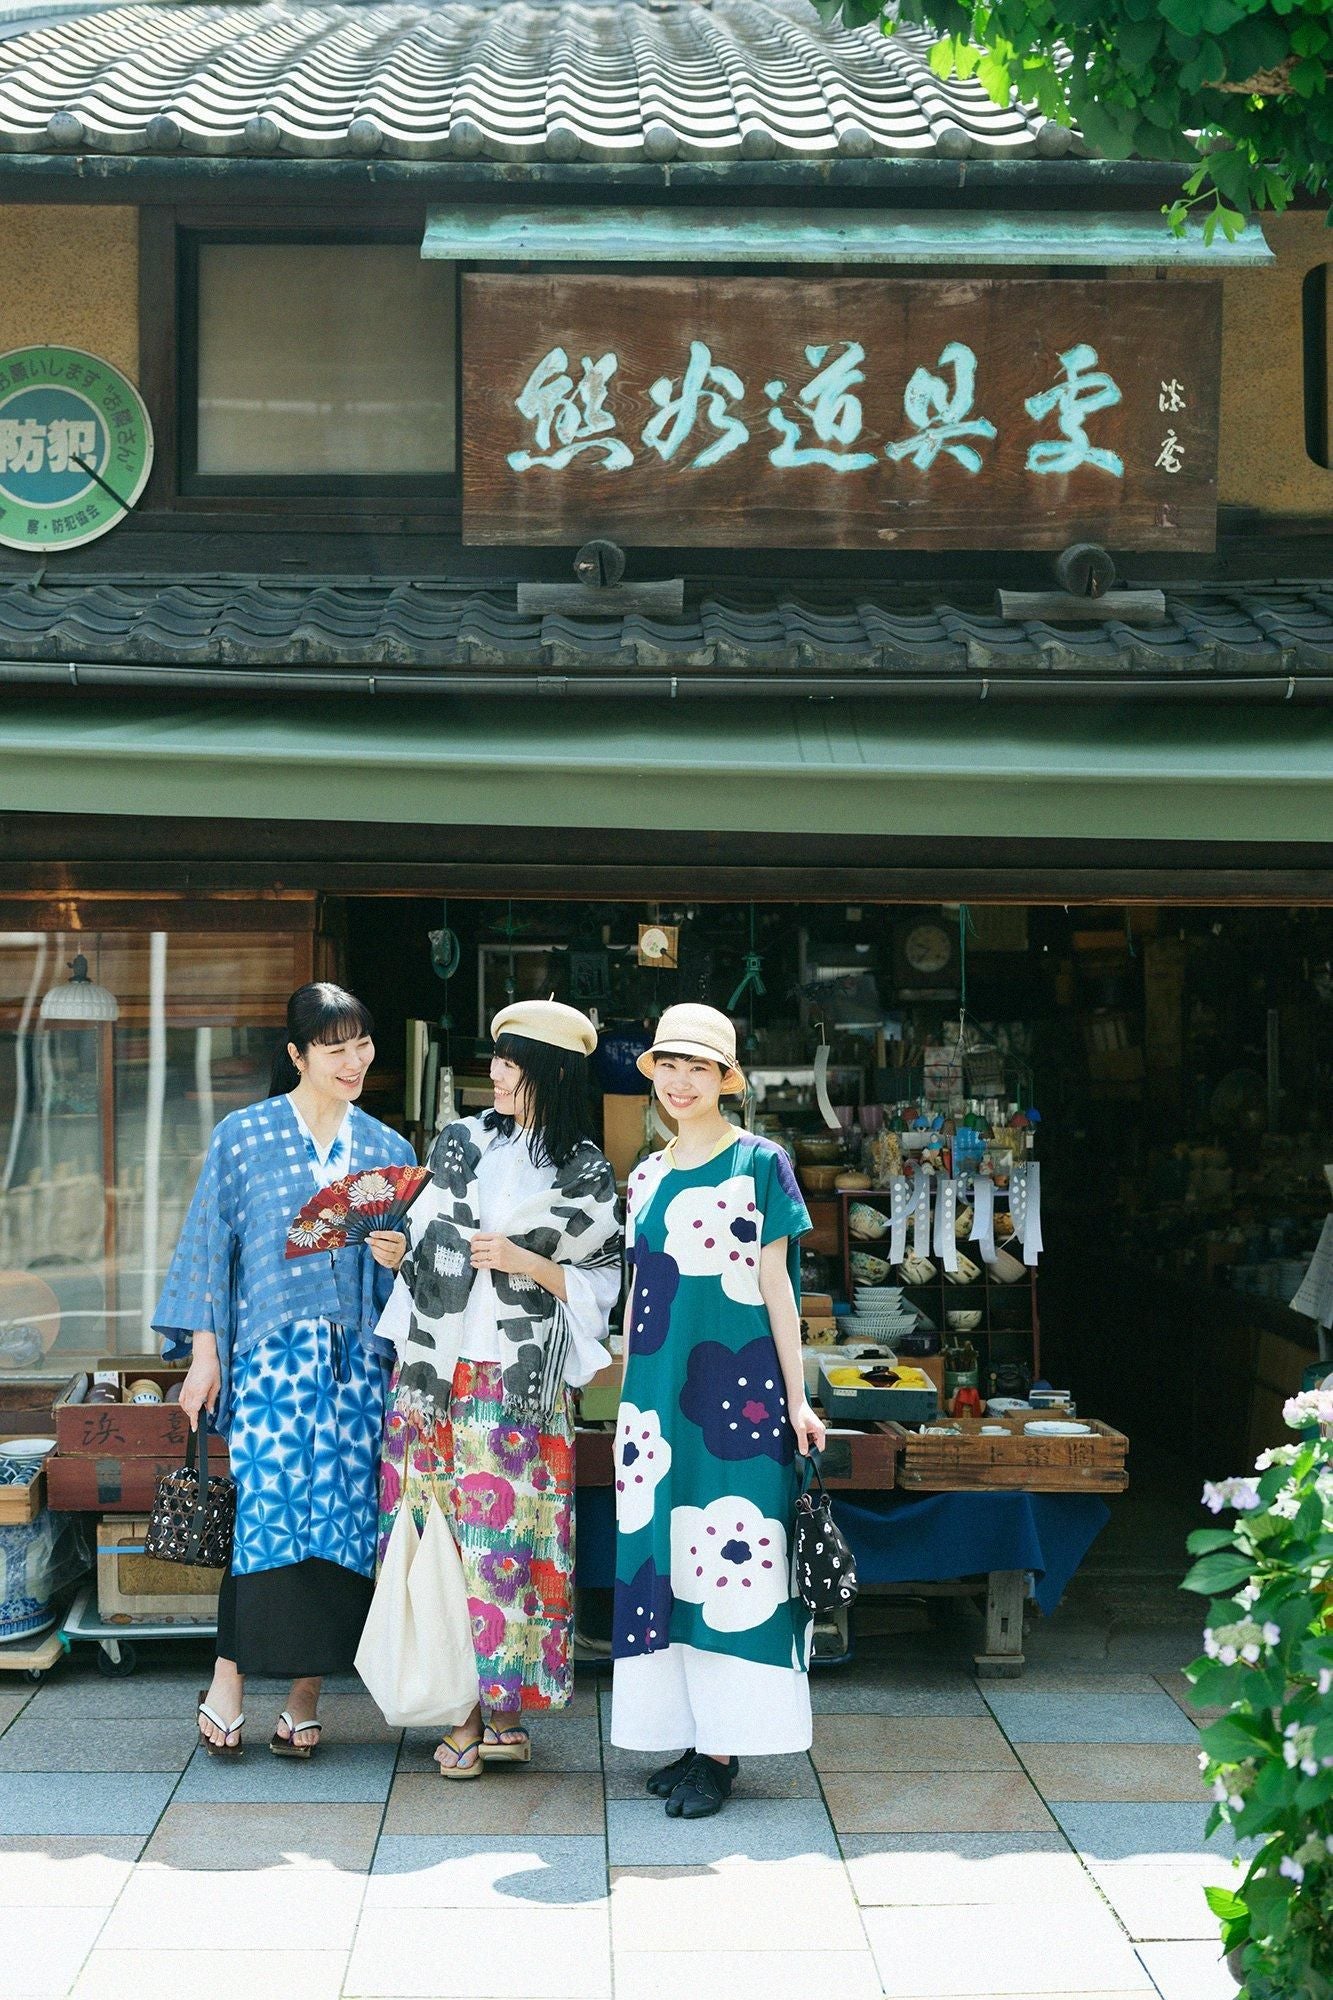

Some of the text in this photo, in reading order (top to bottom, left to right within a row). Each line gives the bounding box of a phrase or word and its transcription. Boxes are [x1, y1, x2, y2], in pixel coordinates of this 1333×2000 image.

[0, 418, 97, 473] 防犯
[815, 1542, 824, 1555] 9
[832, 1556, 840, 1569] 6
[823, 1578, 831, 1589] 7
[840, 1587, 851, 1599] 0
